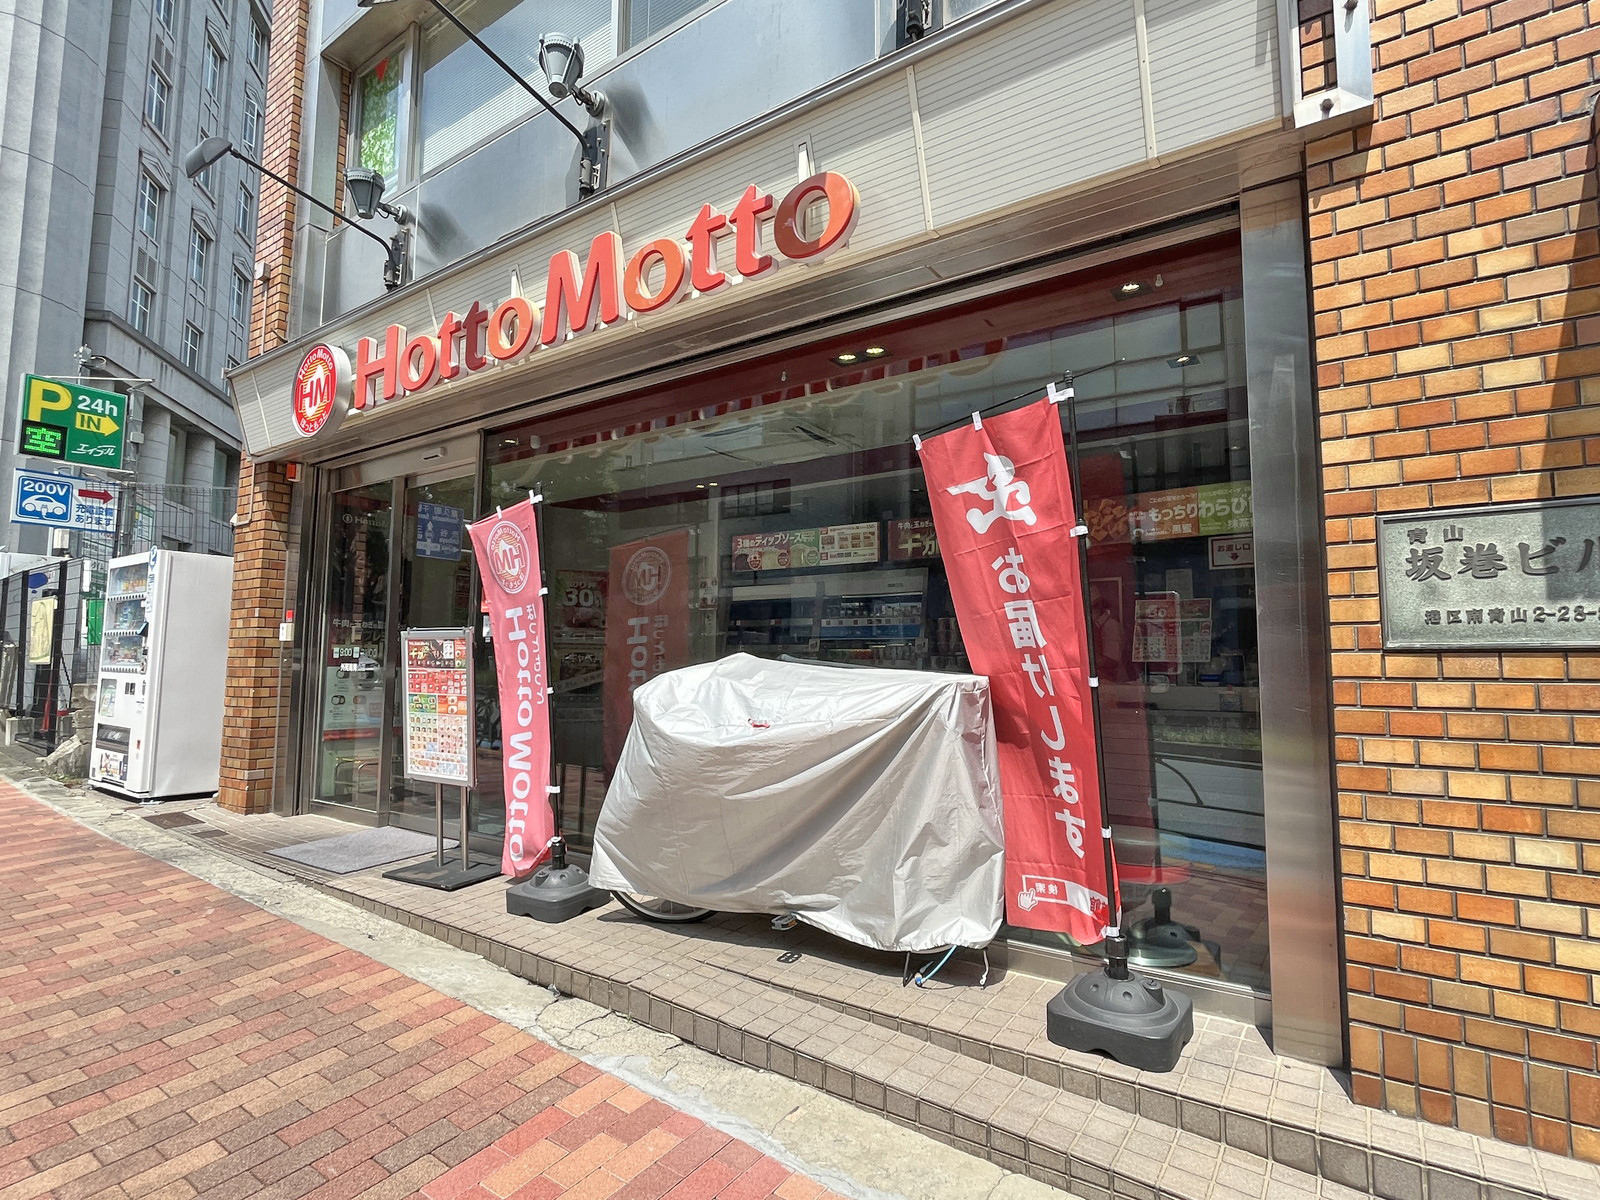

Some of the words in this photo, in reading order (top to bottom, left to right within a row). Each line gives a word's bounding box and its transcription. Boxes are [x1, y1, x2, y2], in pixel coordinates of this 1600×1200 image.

[354, 170, 859, 410] HottoMotto
[28, 378, 72, 422] P
[77, 395, 118, 417] 24h
[80, 411, 101, 432] IN
[299, 411, 329, 432] ほっともっと
[23, 480, 68, 496] 200V
[75, 514, 113, 527] あります
[1406, 524, 1464, 545] 青山
[1424, 605, 1600, 626] 港区南青山2-28-
